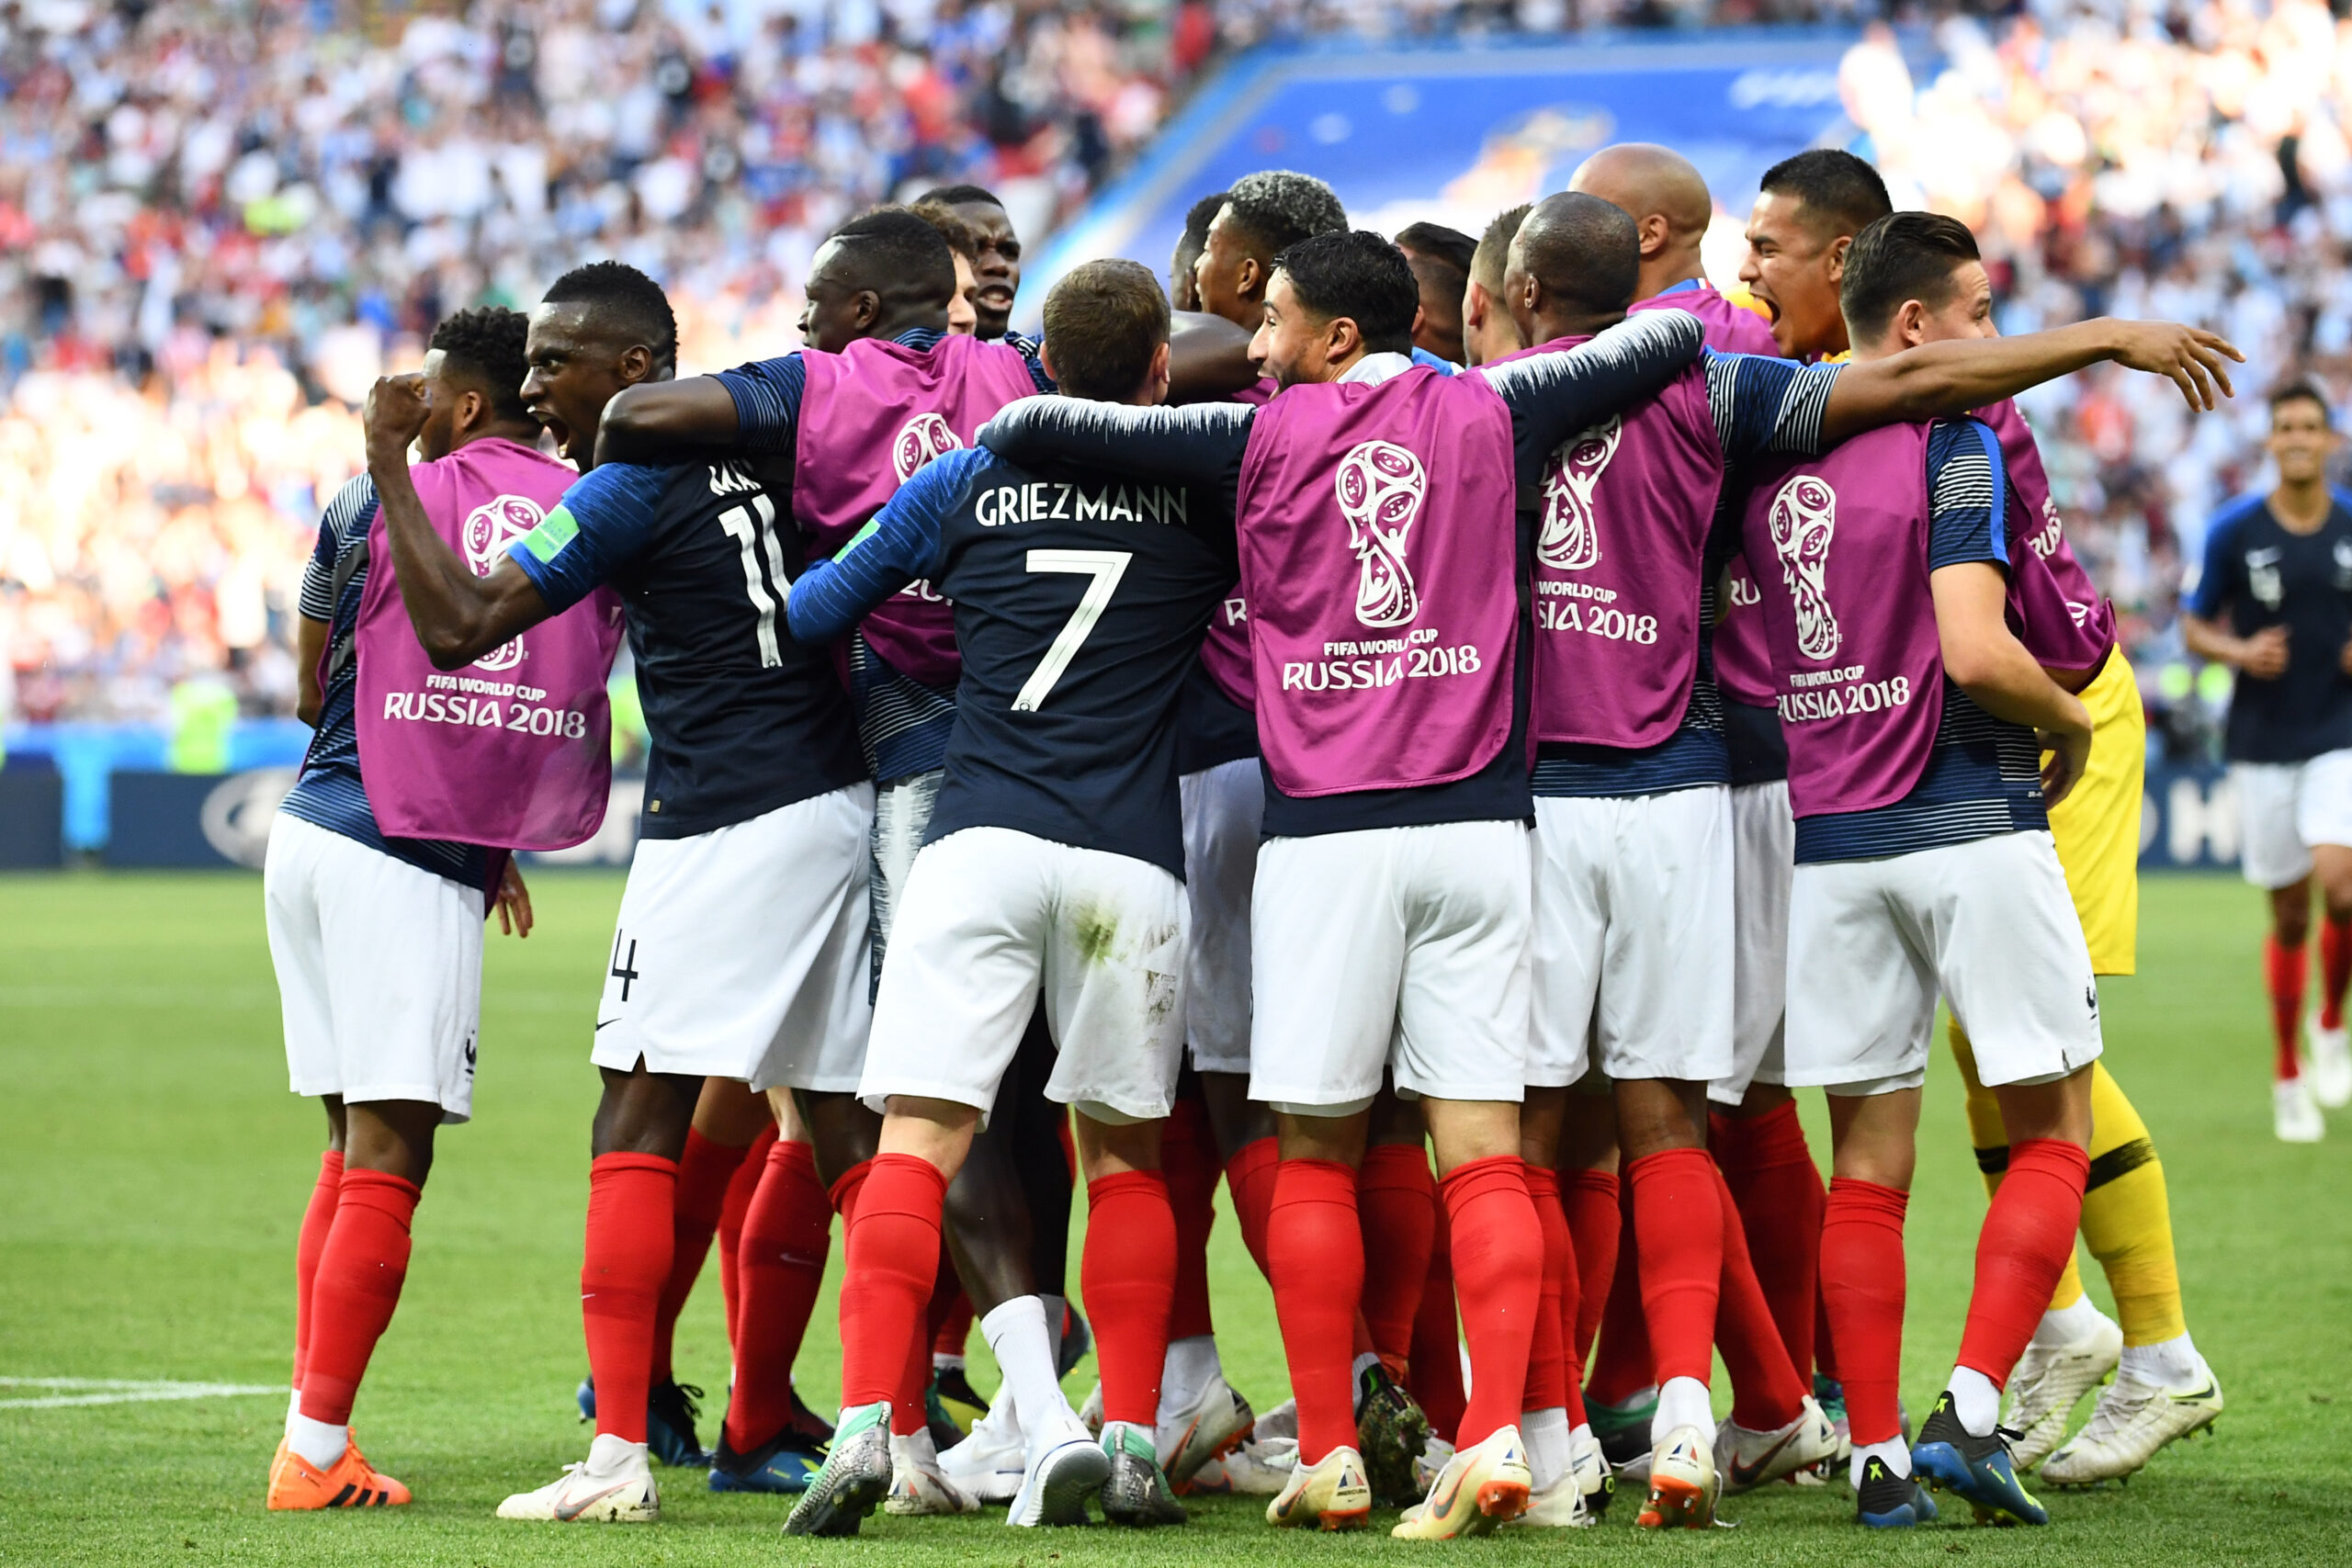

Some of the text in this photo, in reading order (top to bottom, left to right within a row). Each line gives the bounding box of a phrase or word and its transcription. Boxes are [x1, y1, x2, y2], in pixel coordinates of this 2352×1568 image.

[975, 482, 1187, 526] GRIEZMANN
[1538, 581, 1617, 604] WORLD CUP
[1011, 549, 1134, 713] 7
[1324, 641, 1359, 656] FIFA
[1408, 628, 1439, 644] CUP
[1587, 606, 1657, 645] 2018
[1283, 645, 1481, 691] RUSSIA 2018
[1806, 669, 1844, 686] WORLD
[1844, 665, 1865, 681] CUP
[426, 674, 547, 702] FIFA WORLD CUP
[1845, 676, 1910, 715] 2018
[383, 692, 586, 739] RUSSIA 2018
[611, 928, 639, 1002] 4
